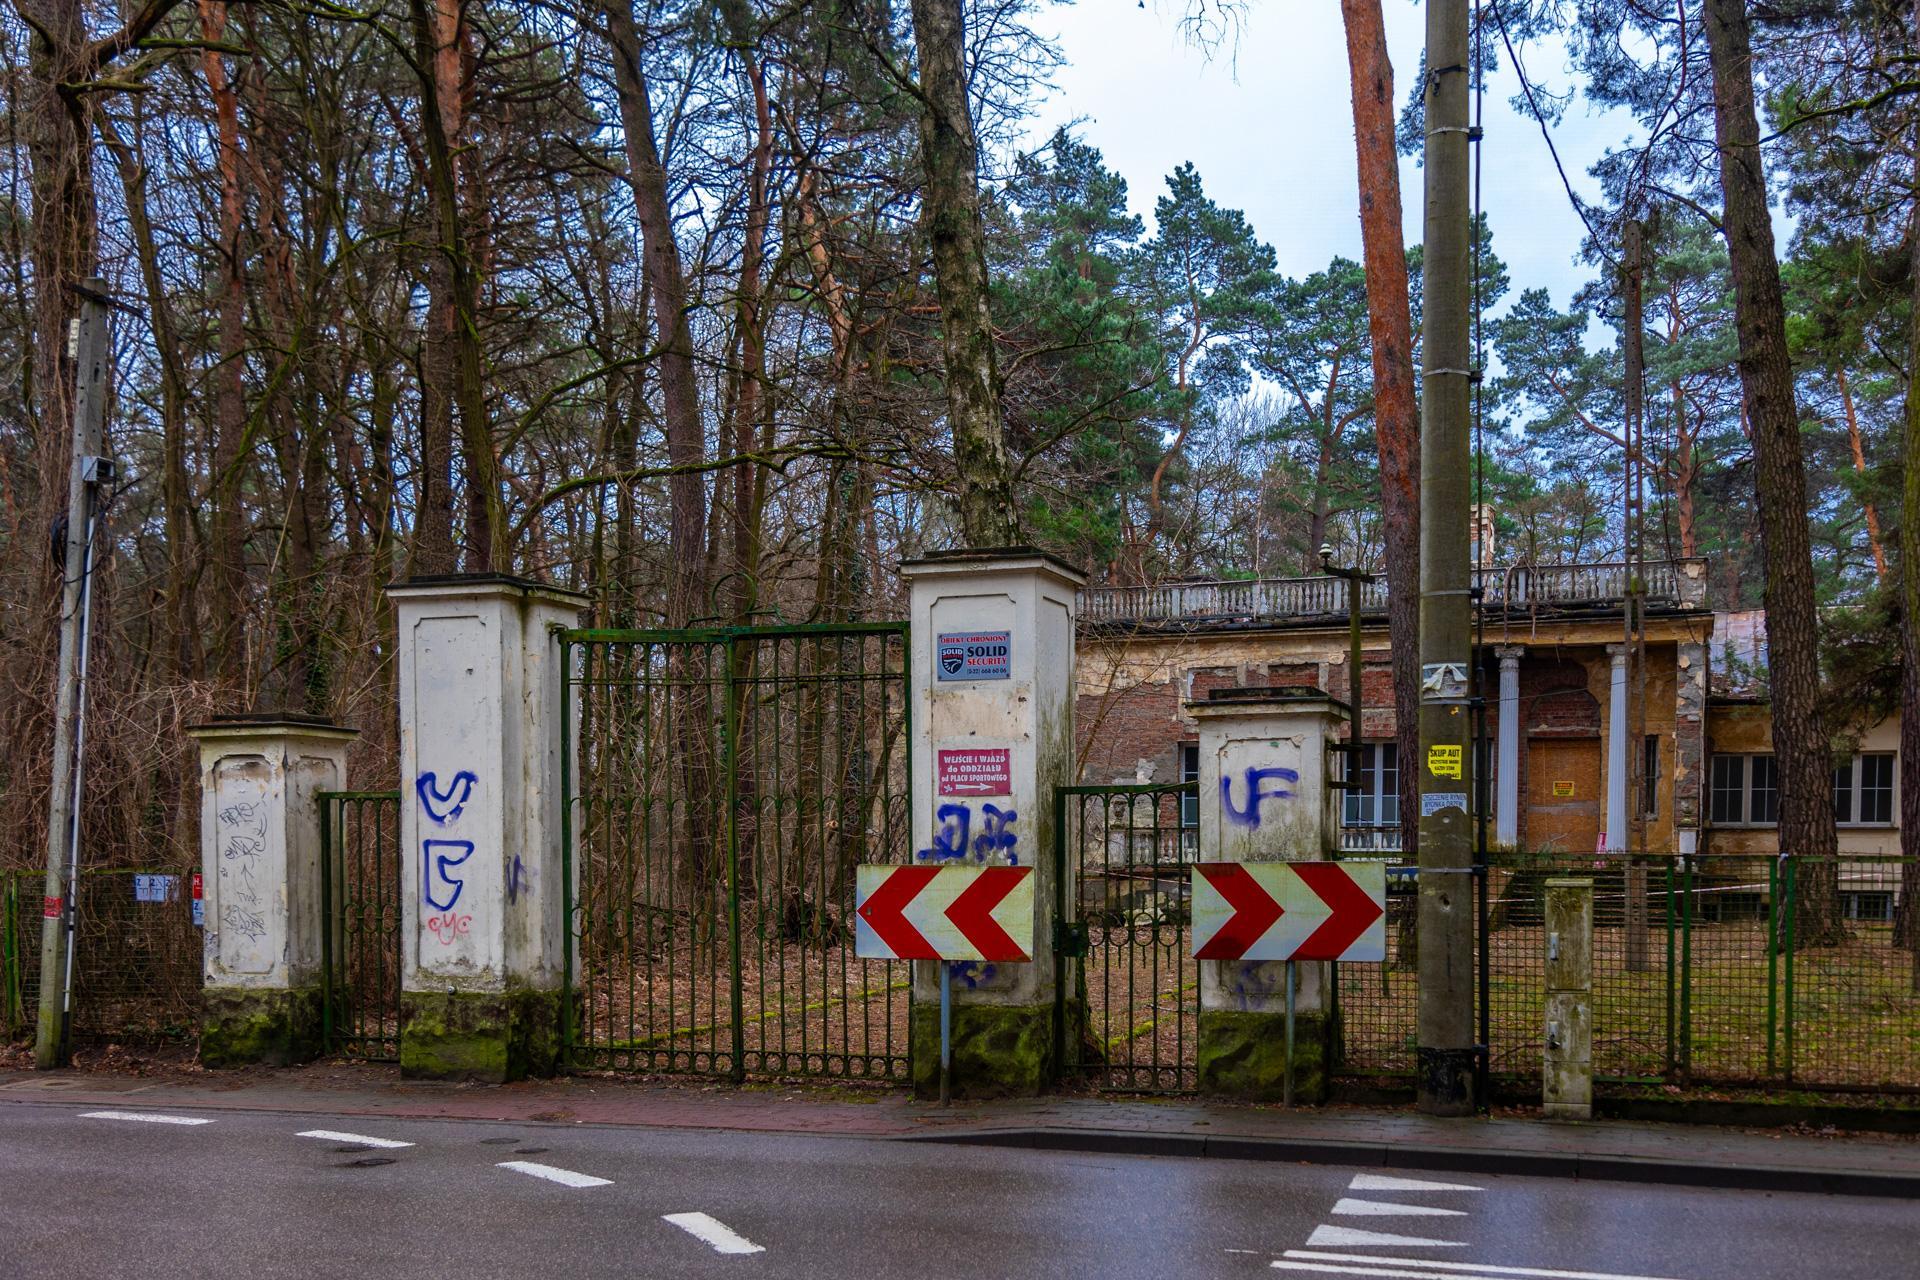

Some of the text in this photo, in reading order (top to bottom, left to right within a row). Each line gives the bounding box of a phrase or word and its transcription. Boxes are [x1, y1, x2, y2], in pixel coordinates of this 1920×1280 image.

[966, 635, 1006, 643] CHRONIONY
[967, 646, 1007, 657] SOLID
[967, 657, 1007, 666] SECURITY
[1430, 749, 1460, 758] SKUP AUT
[944, 755, 973, 764] WEJŚCIE
[980, 755, 1006, 763] WJAZD
[947, 764, 1002, 773] do ODDZIAŁU
[941, 774, 1008, 782] od PLACU SPORTOWEGO
